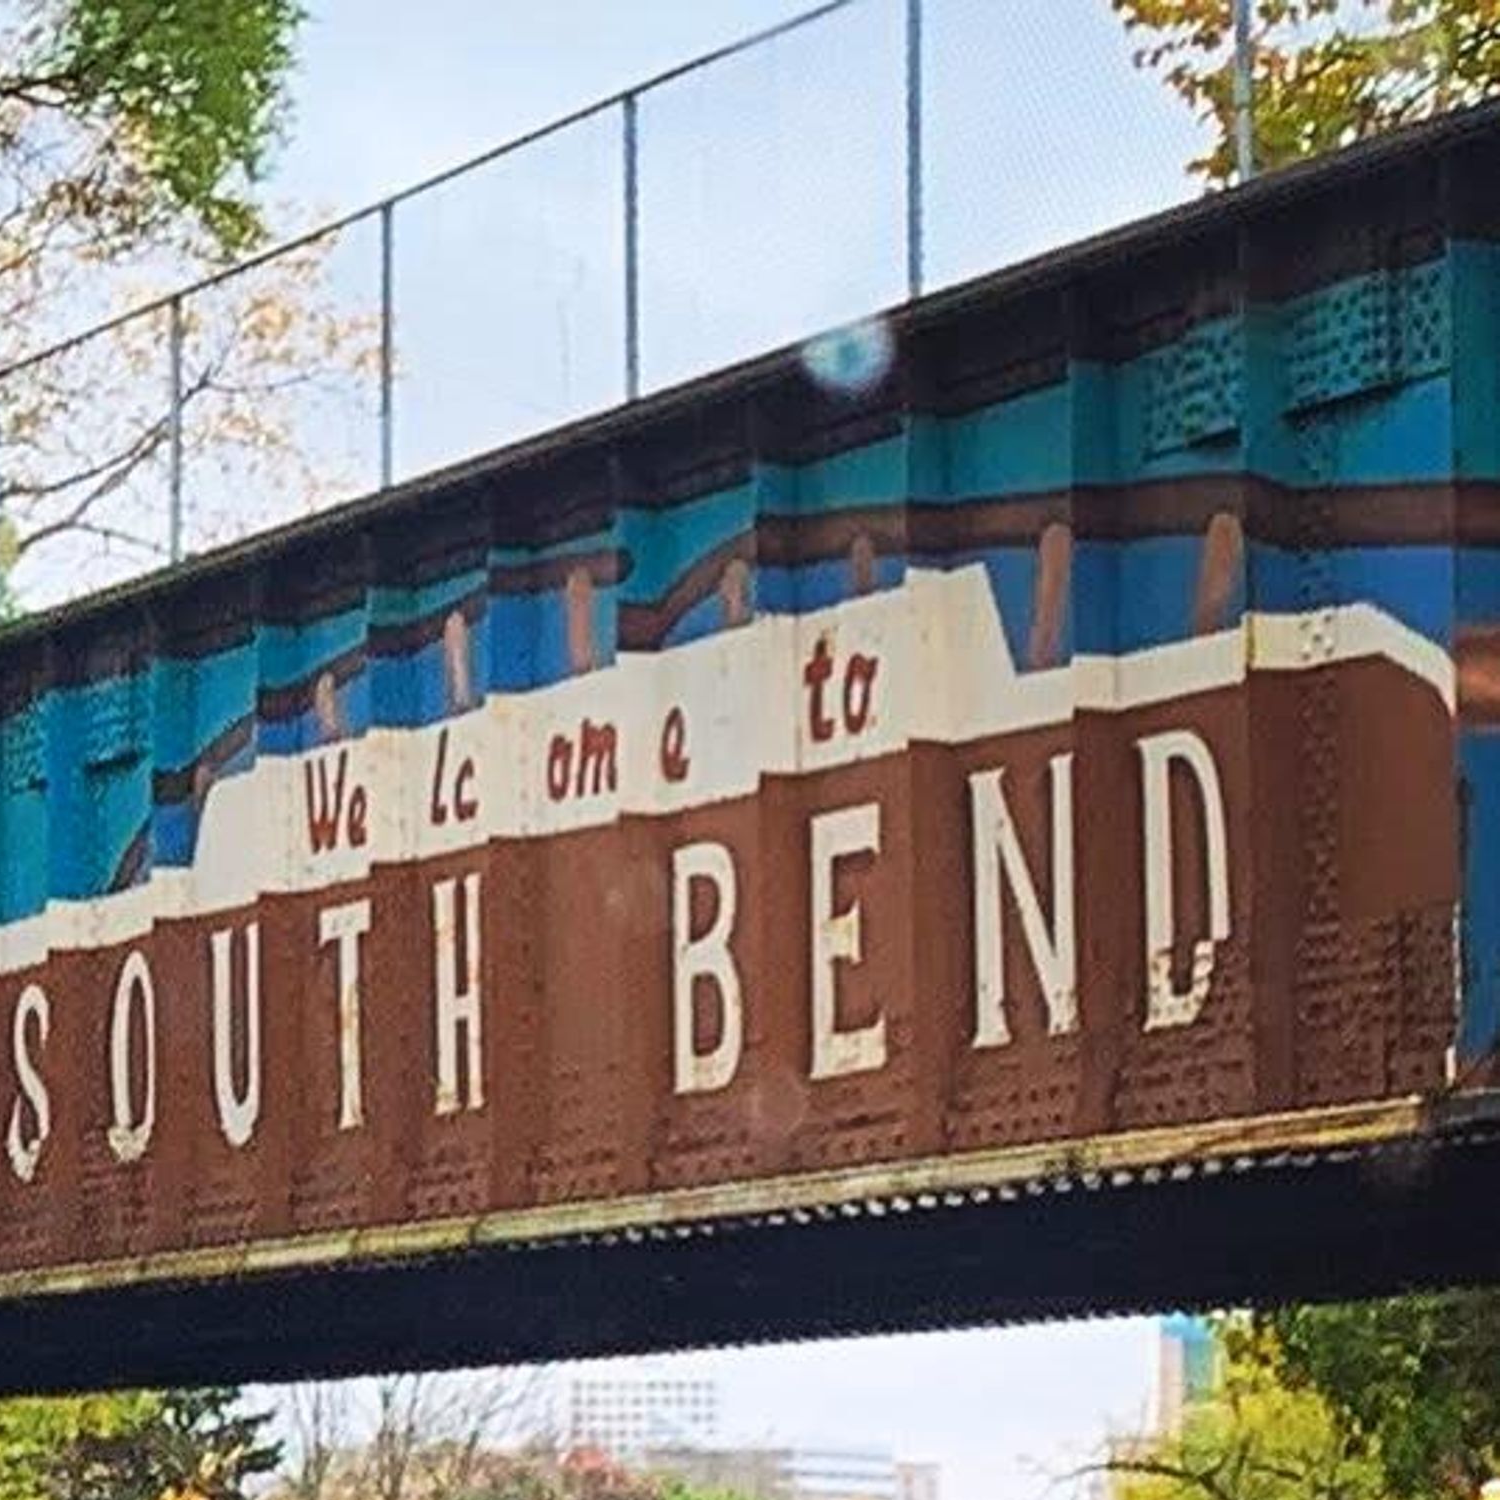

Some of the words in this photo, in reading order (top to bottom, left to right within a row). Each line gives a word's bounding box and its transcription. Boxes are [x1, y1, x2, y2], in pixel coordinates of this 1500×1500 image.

[304, 706, 689, 854] Welcome
[804, 637, 879, 742] to
[7, 872, 485, 1182] SOUTH
[673, 730, 1231, 1096] BEND
